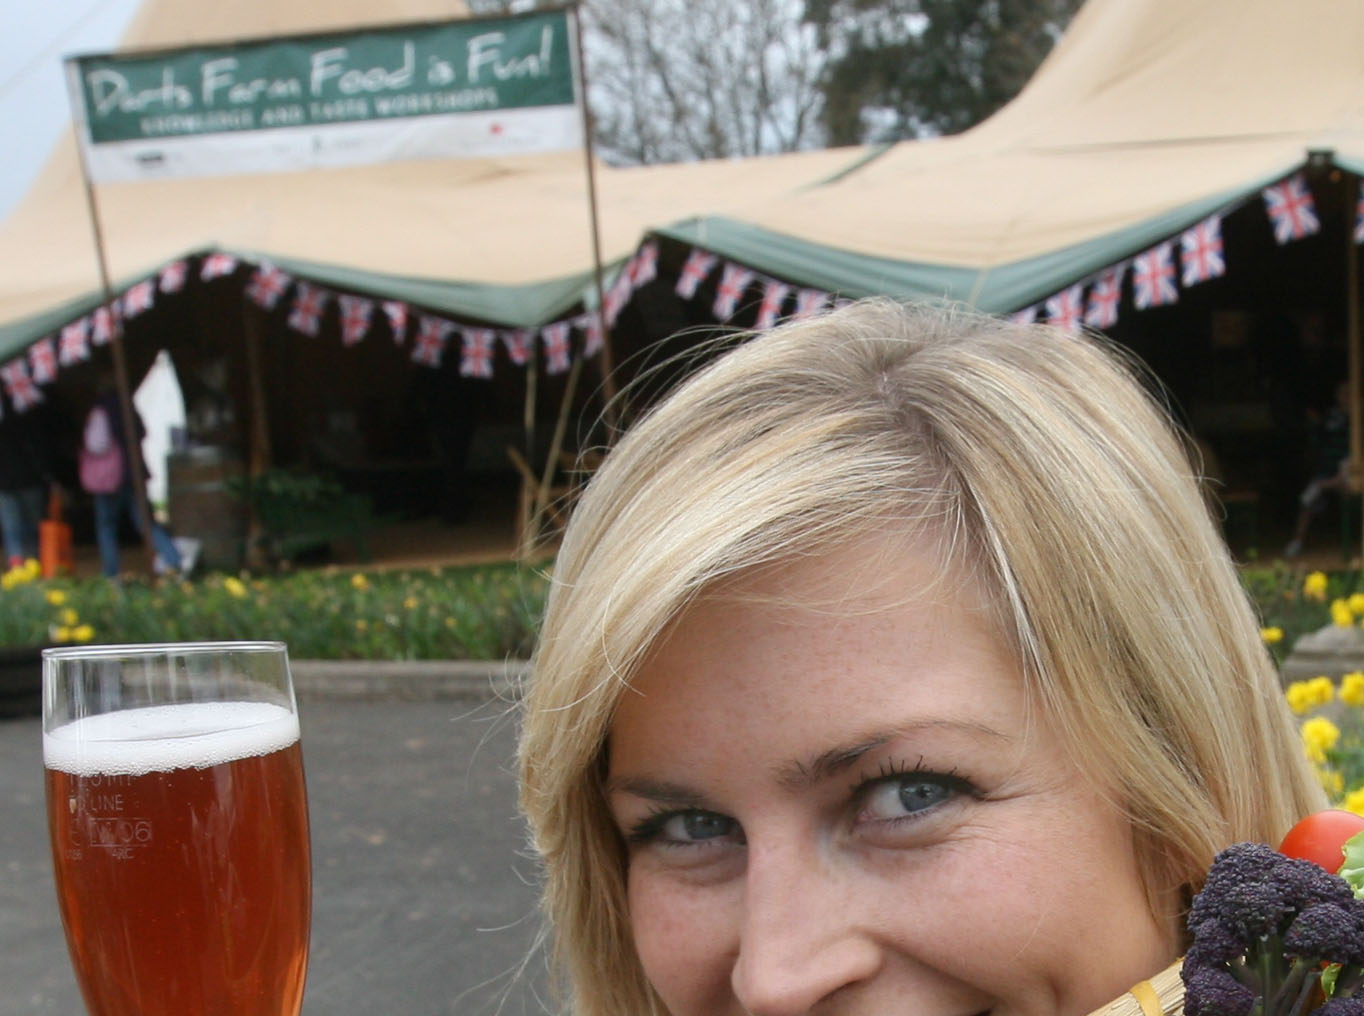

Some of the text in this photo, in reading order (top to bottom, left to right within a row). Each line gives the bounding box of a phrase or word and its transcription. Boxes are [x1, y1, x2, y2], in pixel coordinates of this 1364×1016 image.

[200, 56, 303, 107] Farm
[309, 40, 416, 97] Food
[426, 54, 456, 87] is
[259, 104, 305, 126] AND
